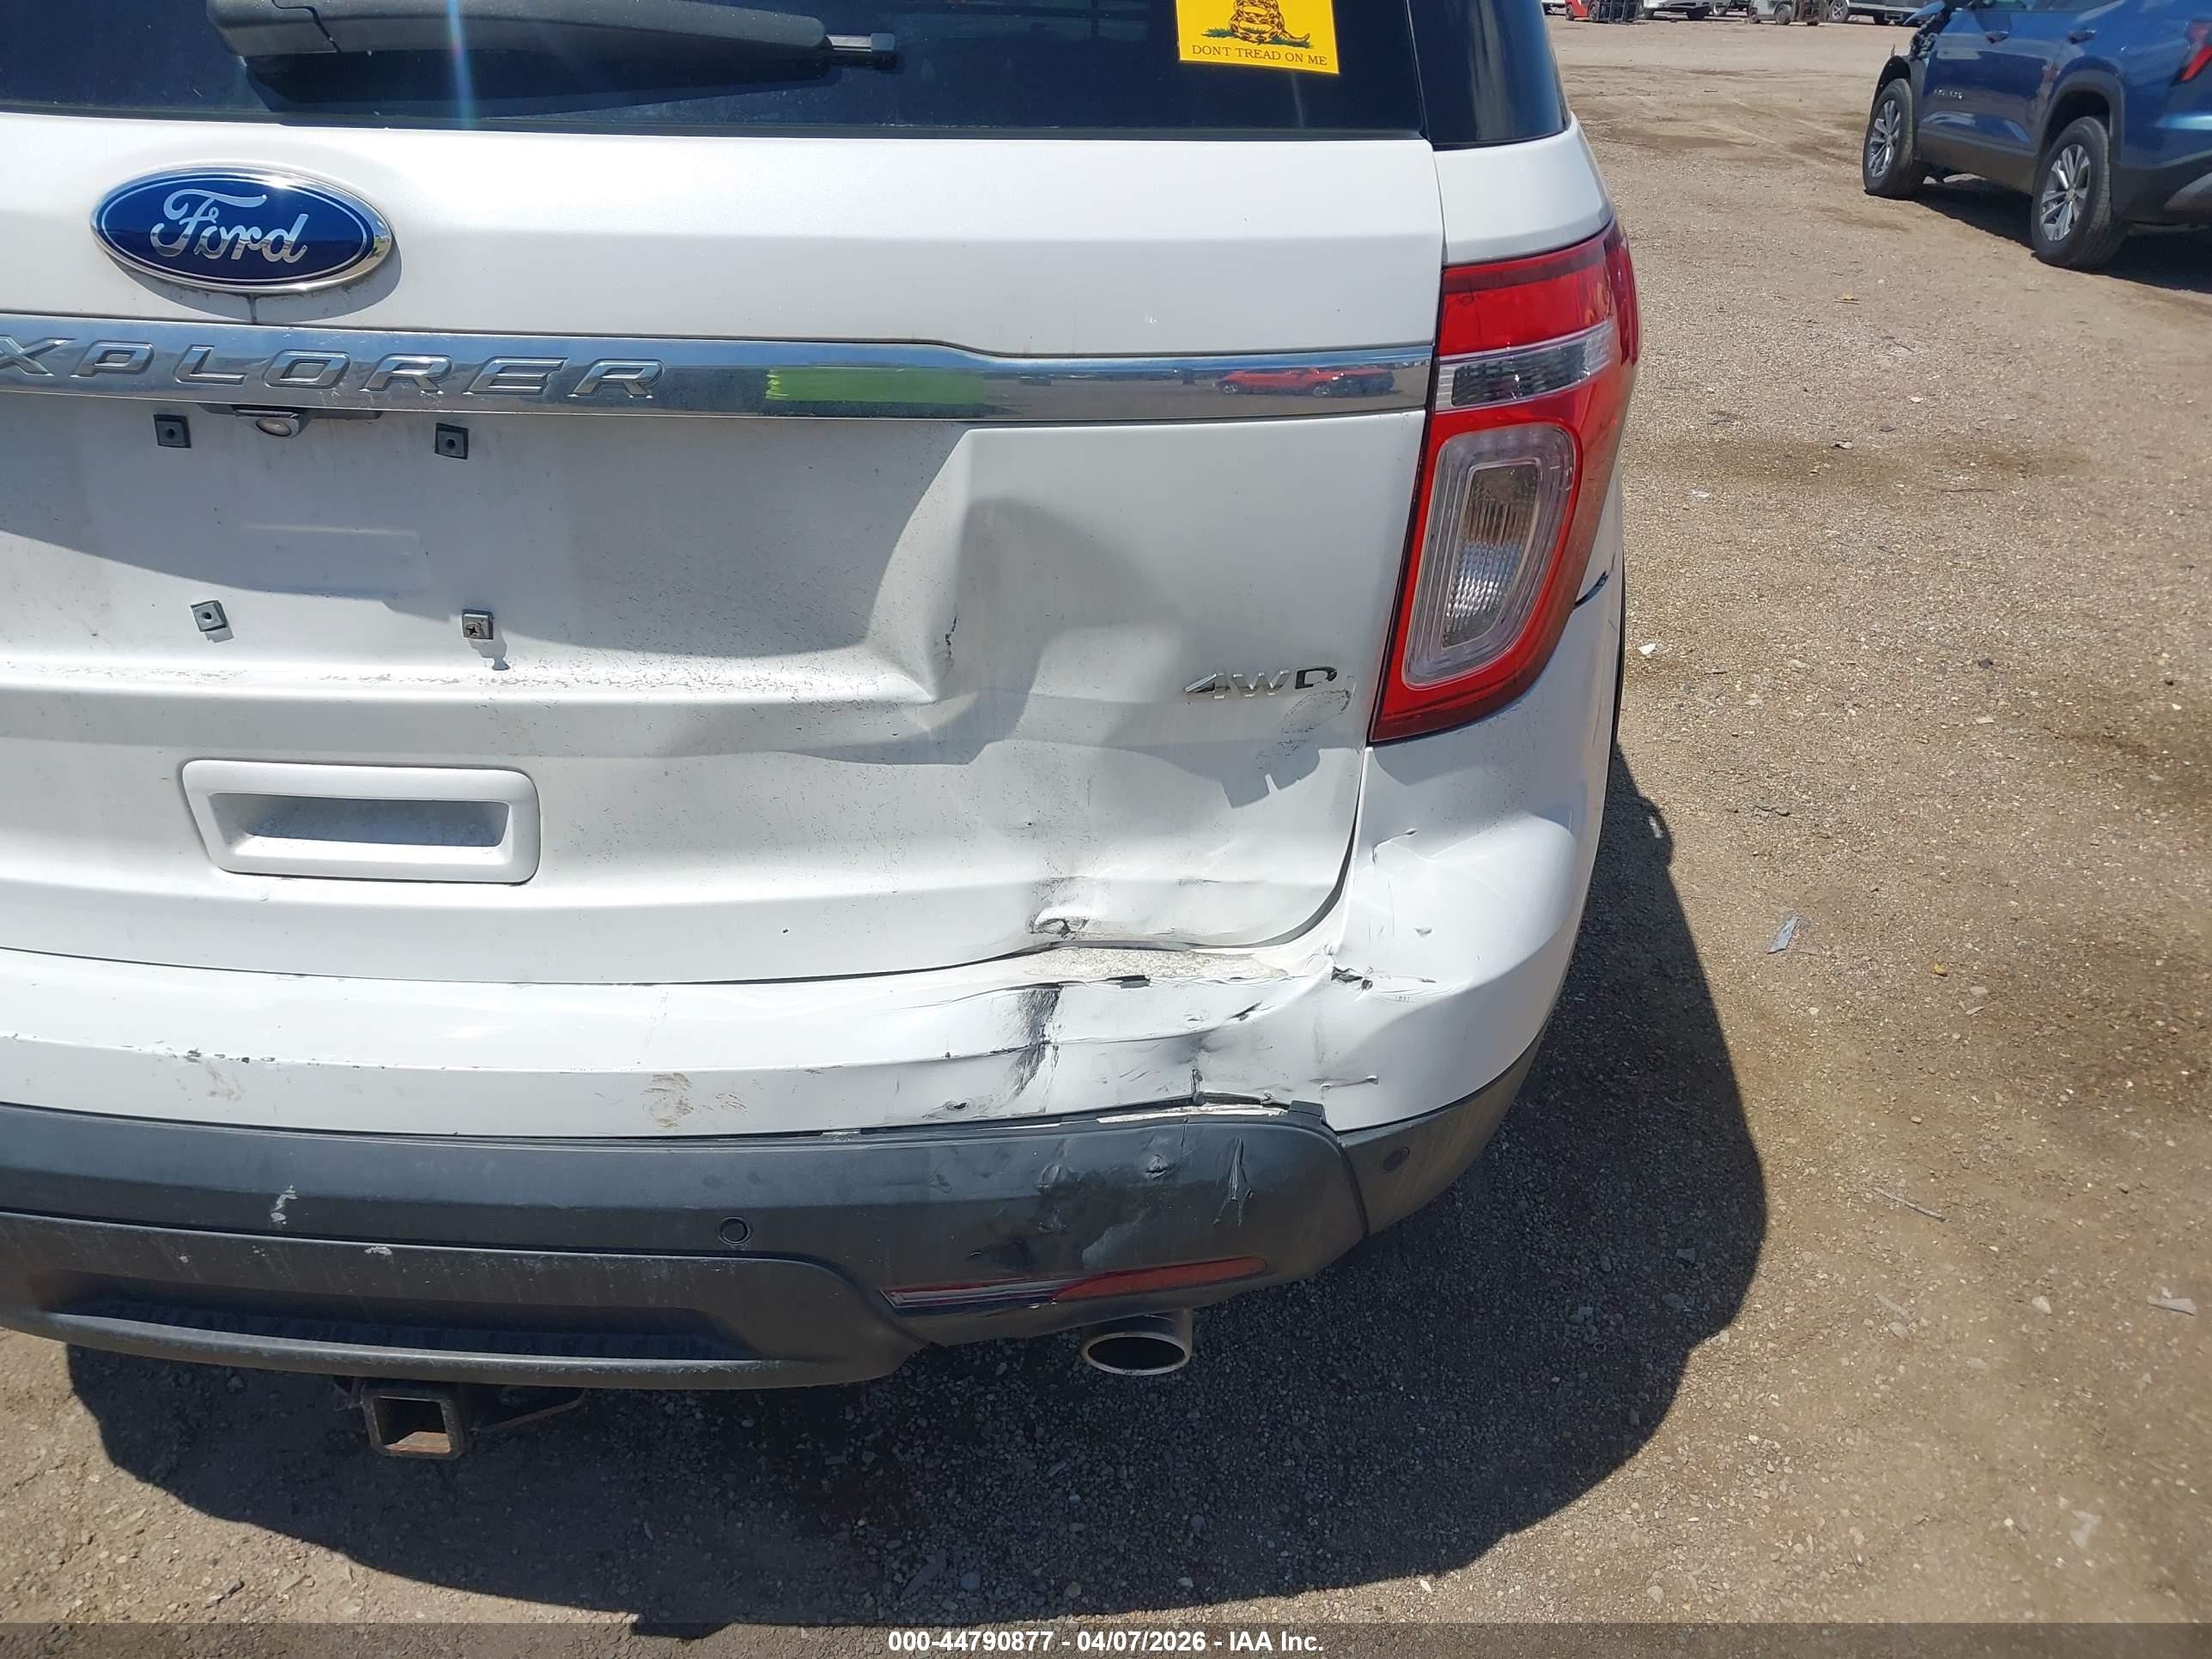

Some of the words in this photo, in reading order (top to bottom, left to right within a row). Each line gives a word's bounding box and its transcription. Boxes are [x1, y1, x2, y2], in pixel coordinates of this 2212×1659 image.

[1192, 45, 1231, 57] DONT
[1237, 47, 1282, 61] TREAD
[1285, 52, 1304, 64] ON
[1308, 55, 1328, 67] ME
[149, 188, 310, 264] Ford
[0, 336, 667, 399] XPLORER
[1182, 666, 1338, 700] 4WD
